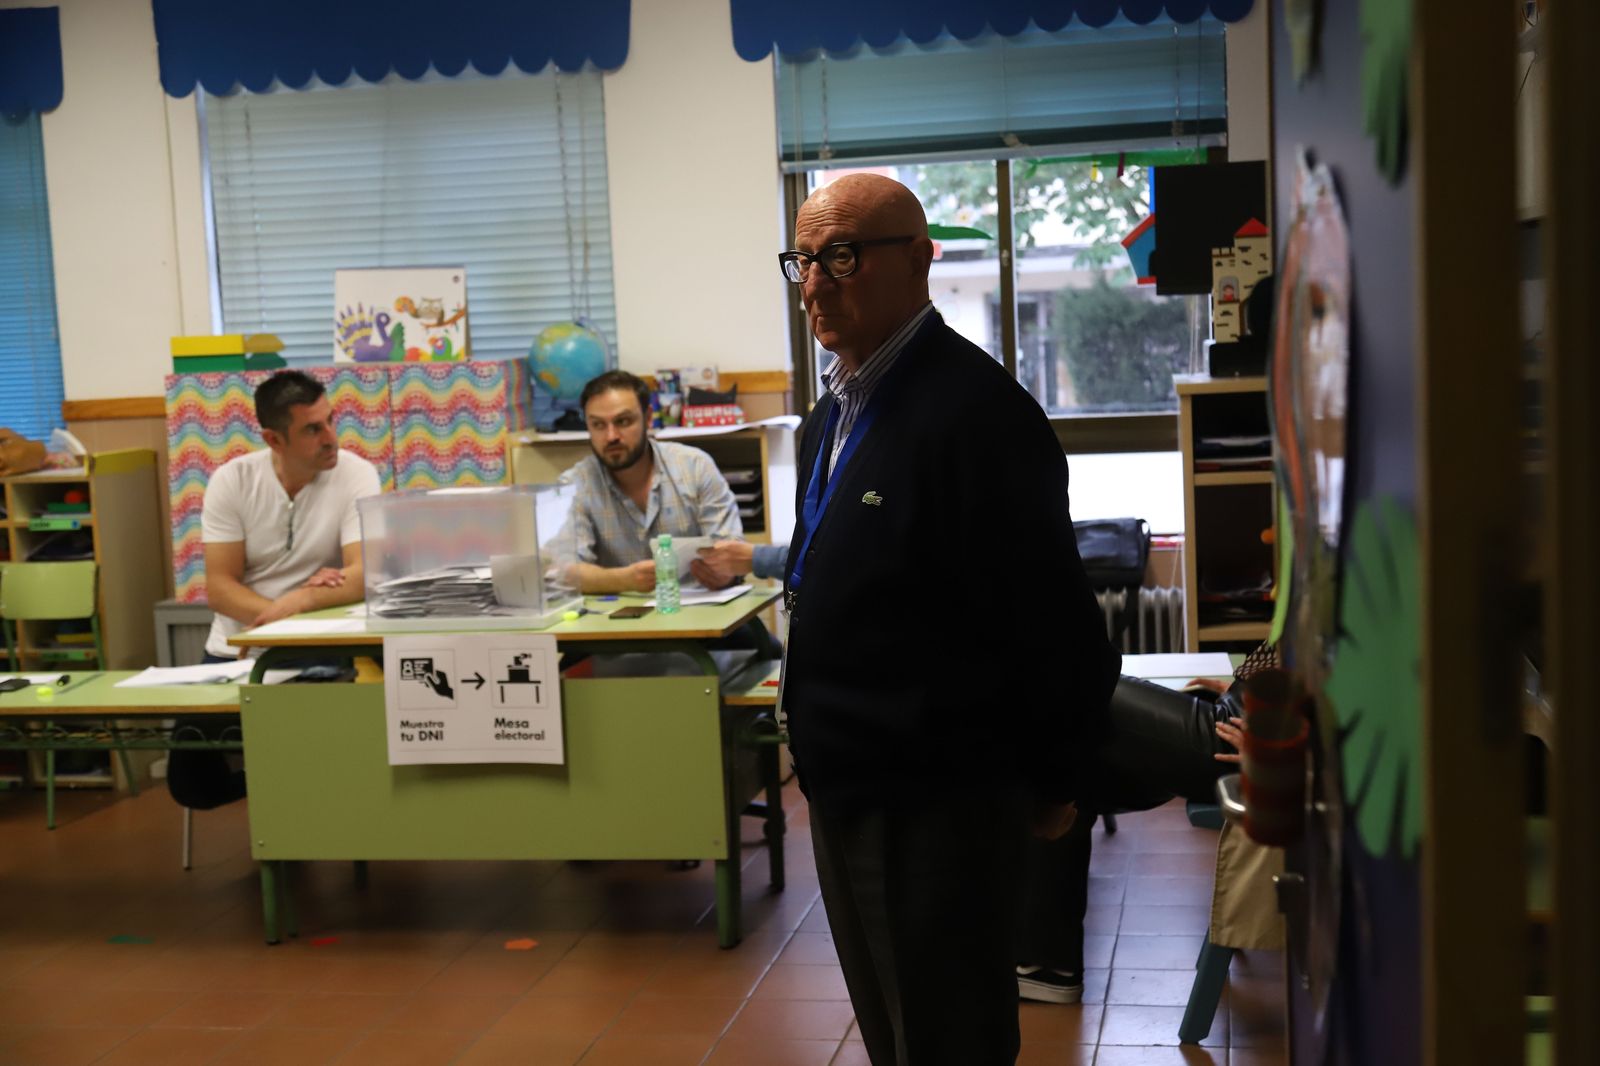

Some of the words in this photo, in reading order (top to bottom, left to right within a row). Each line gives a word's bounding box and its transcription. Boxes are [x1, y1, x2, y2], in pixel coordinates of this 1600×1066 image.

[399, 720, 445, 729] Muestra
[494, 717, 529, 729] Mesa
[400, 732, 414, 742] tu
[418, 730, 444, 742] DNI
[494, 729, 546, 741] electoral
